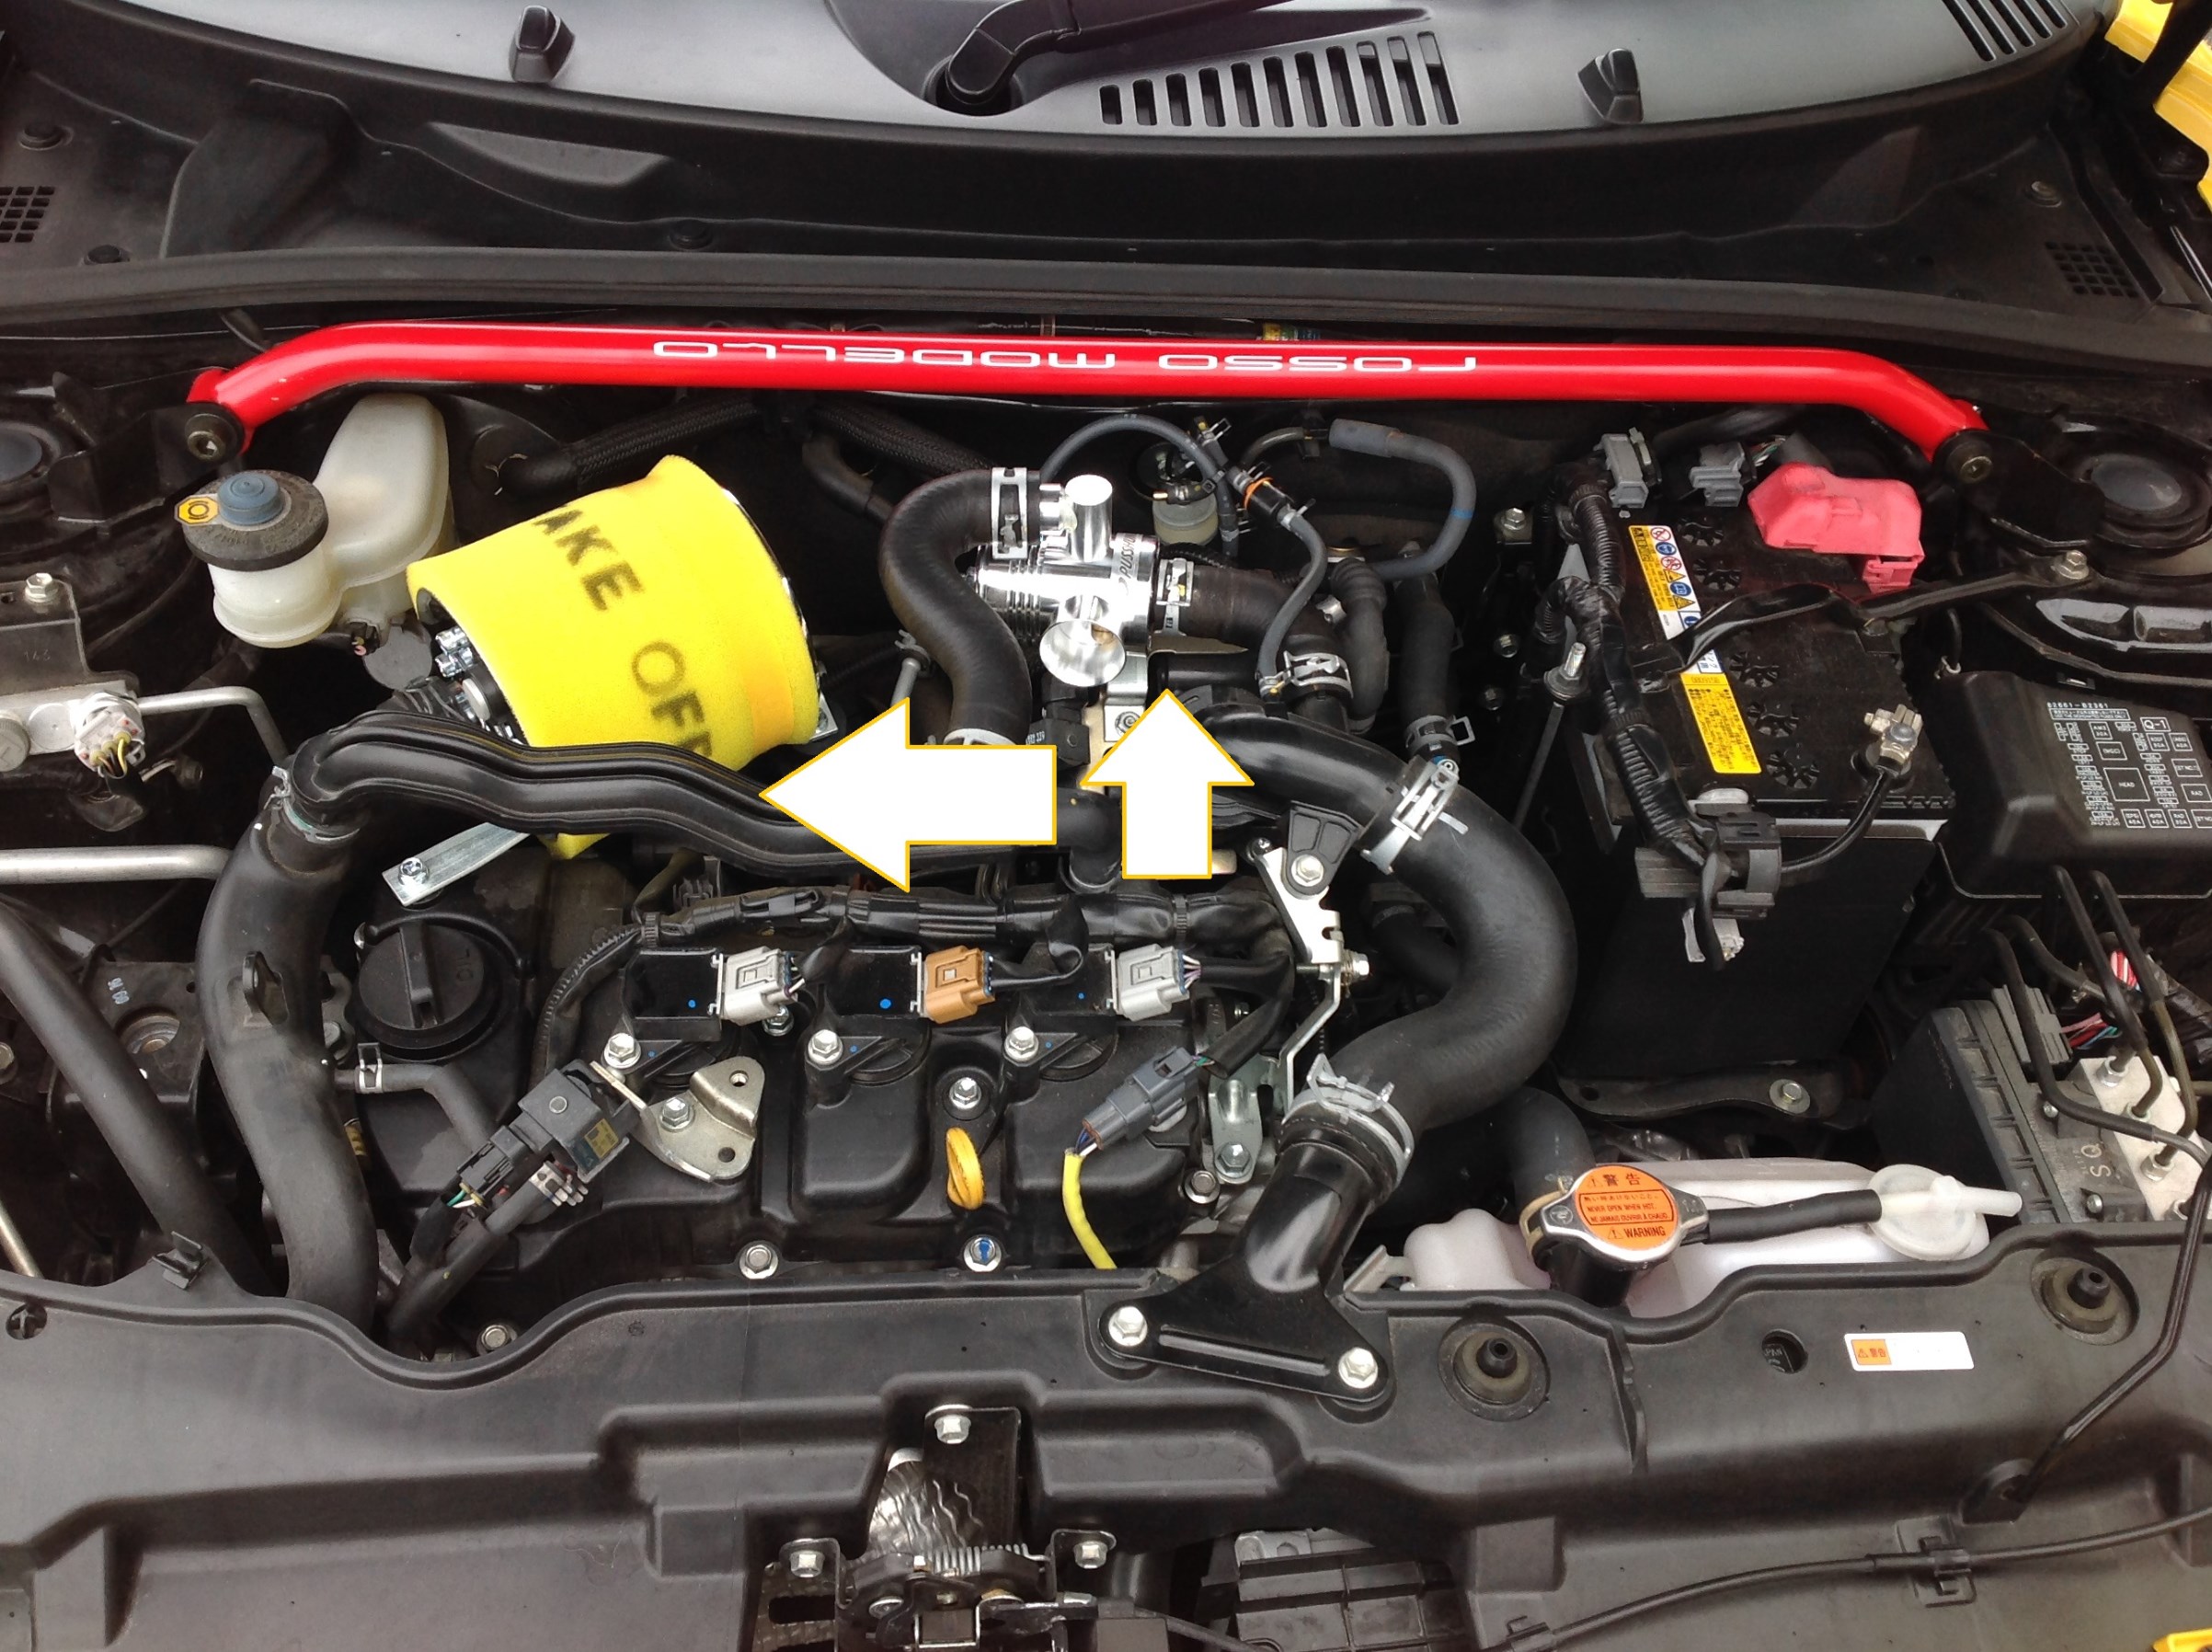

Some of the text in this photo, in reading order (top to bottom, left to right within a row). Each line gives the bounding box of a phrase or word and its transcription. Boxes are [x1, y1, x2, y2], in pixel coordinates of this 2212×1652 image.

[533, 508, 645, 612] AKE
[2144, 719, 2167, 729] Q-1
[1602, 1173, 1641, 1187] 警告
[1623, 1225, 1667, 1238] WARNING
